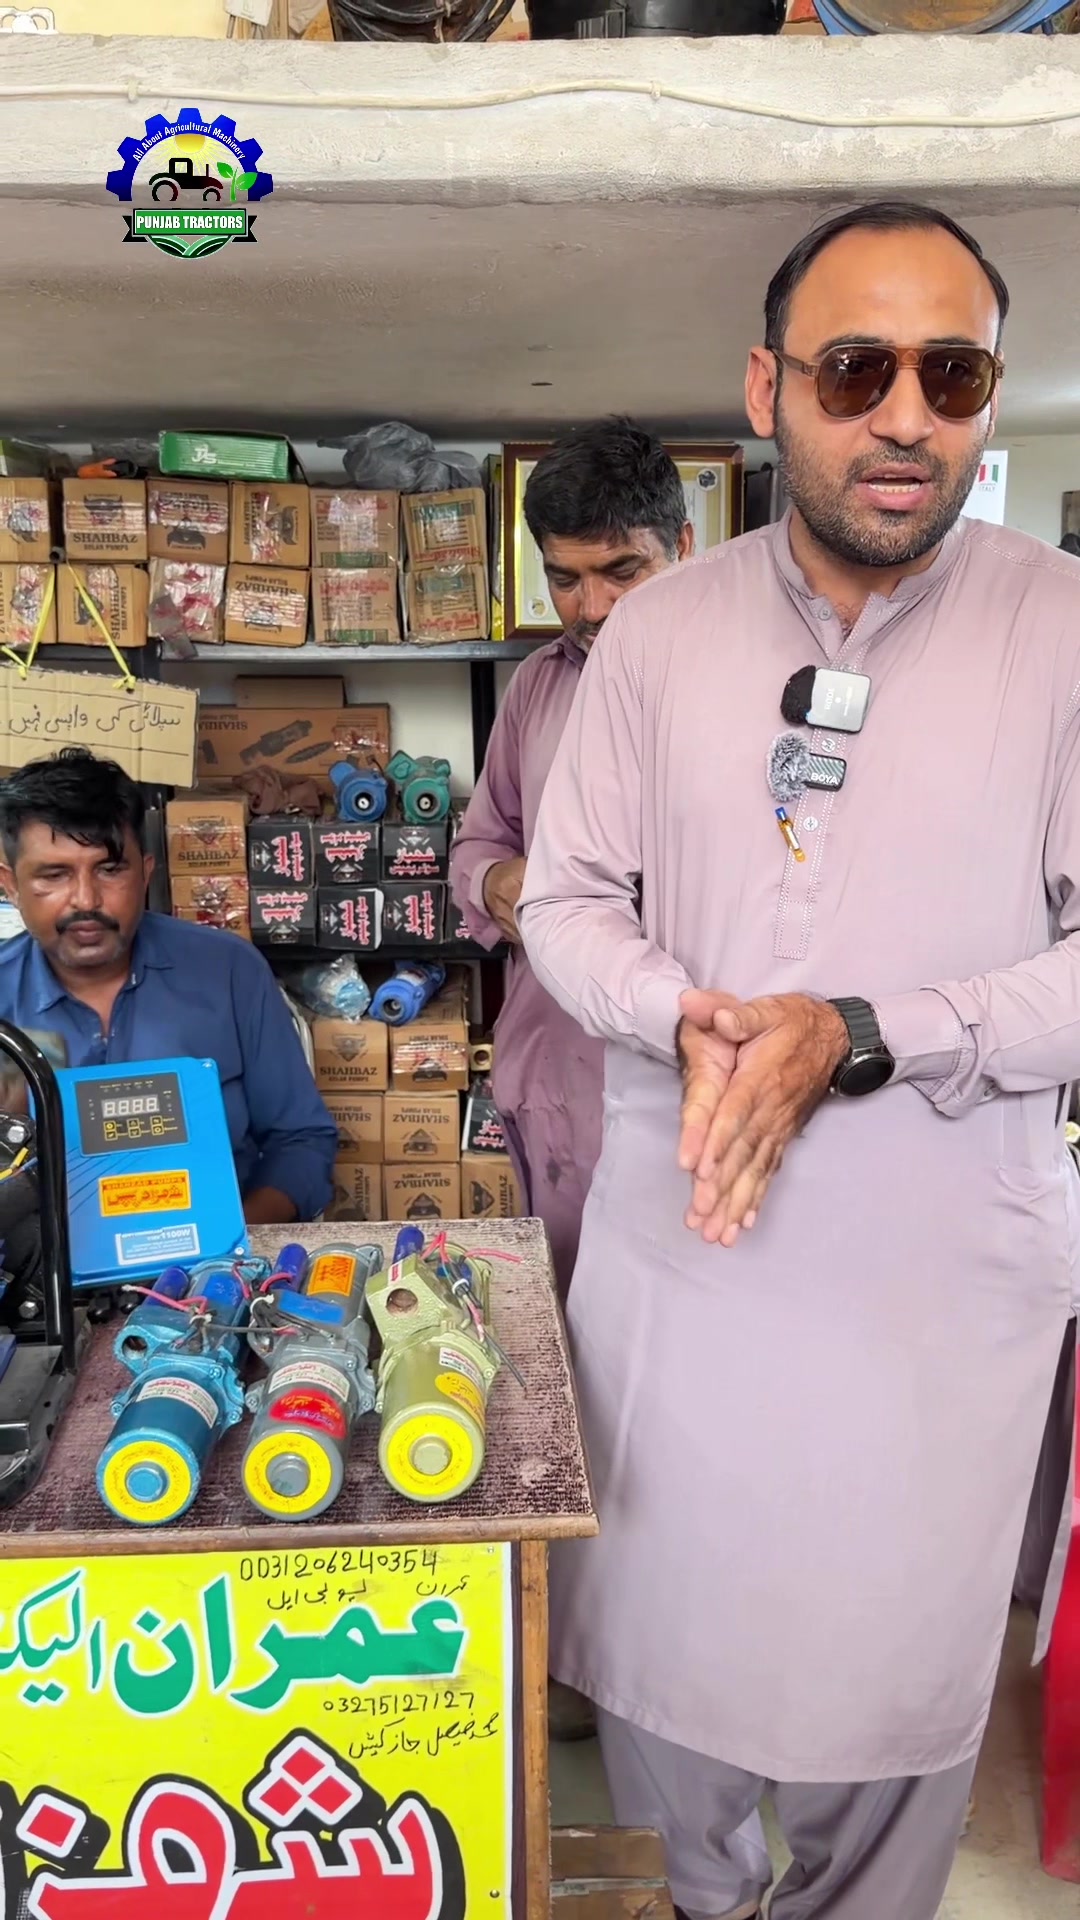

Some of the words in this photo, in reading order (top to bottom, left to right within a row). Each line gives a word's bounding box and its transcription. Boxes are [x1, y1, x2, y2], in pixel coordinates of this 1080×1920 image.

[73, 533, 138, 543] SHAHBAZ
[199, 721, 248, 731] SHAHBA
[810, 773, 839, 785] BOYA
[178, 849, 239, 861] SHAHBAZ
[320, 1067, 378, 1076] SHAHBAZ
[334, 1112, 372, 1122] SHAH
[392, 1114, 450, 1124] SHAHBAZ
[393, 1178, 451, 1189] SHAHBAZ
[161, 1229, 191, 1239] 1100W
[240, 1550, 438, 1581] 0031206240354
[112, 1573, 466, 1714] عمران
[323, 1691, 475, 1716] 03275127127
